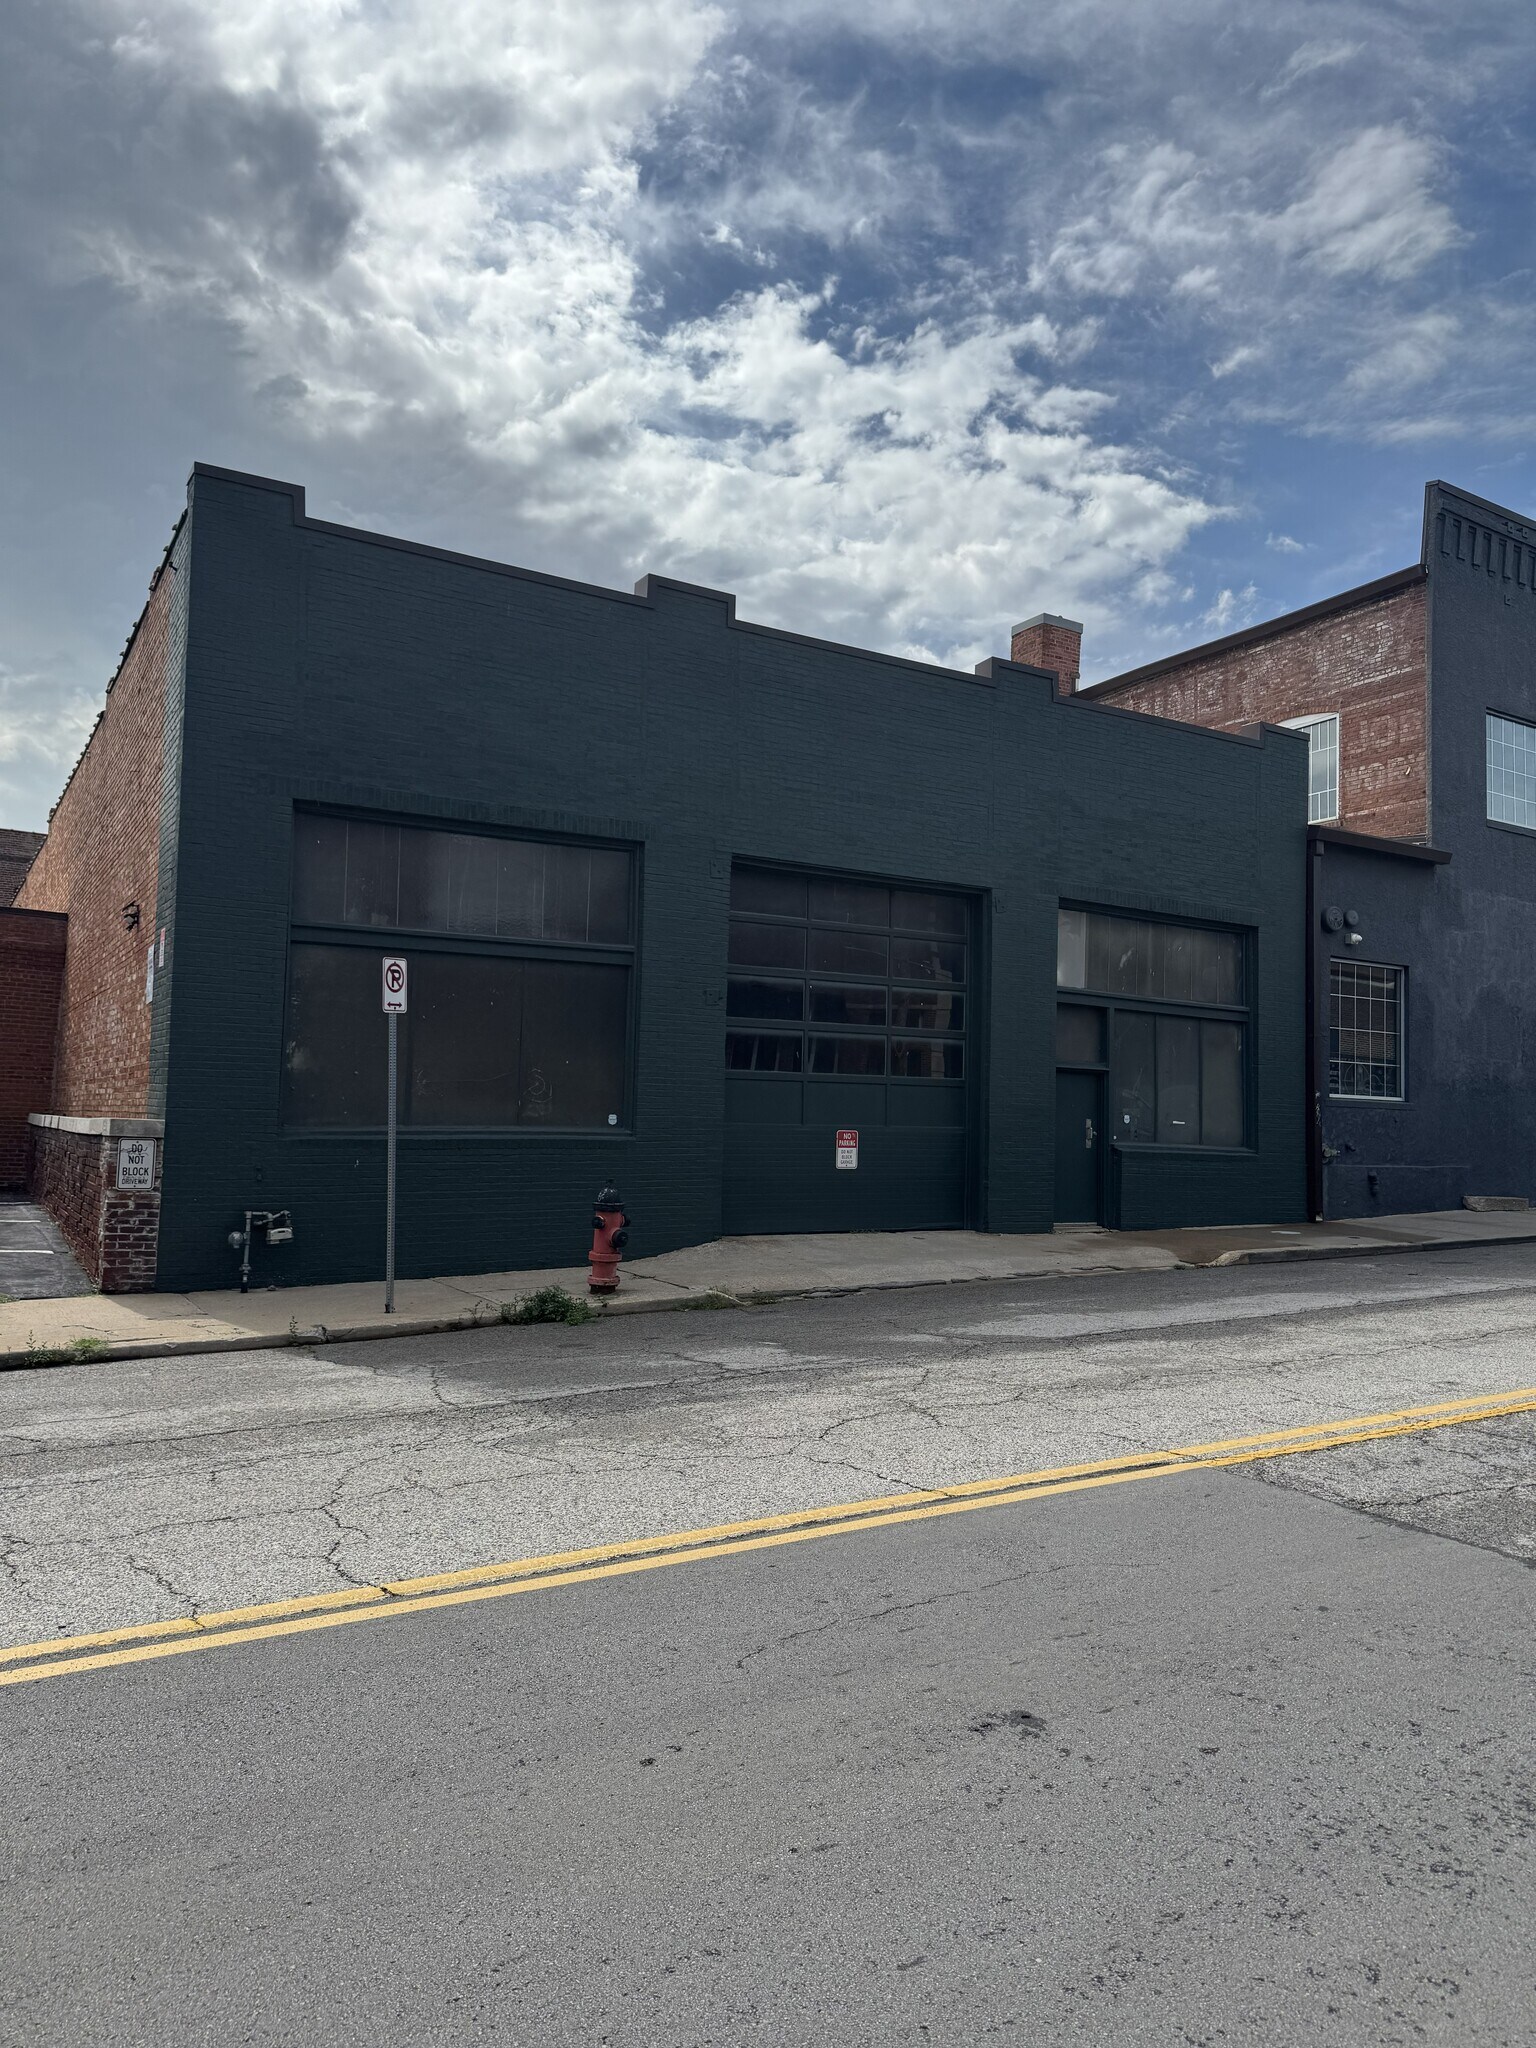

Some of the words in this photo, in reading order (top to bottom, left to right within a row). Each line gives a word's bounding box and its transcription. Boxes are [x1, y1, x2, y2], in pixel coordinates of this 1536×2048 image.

[391, 969, 401, 988] P
[131, 1144, 143, 1152] DO
[128, 1156, 145, 1164] NOT
[122, 1167, 150, 1176] BLOCK
